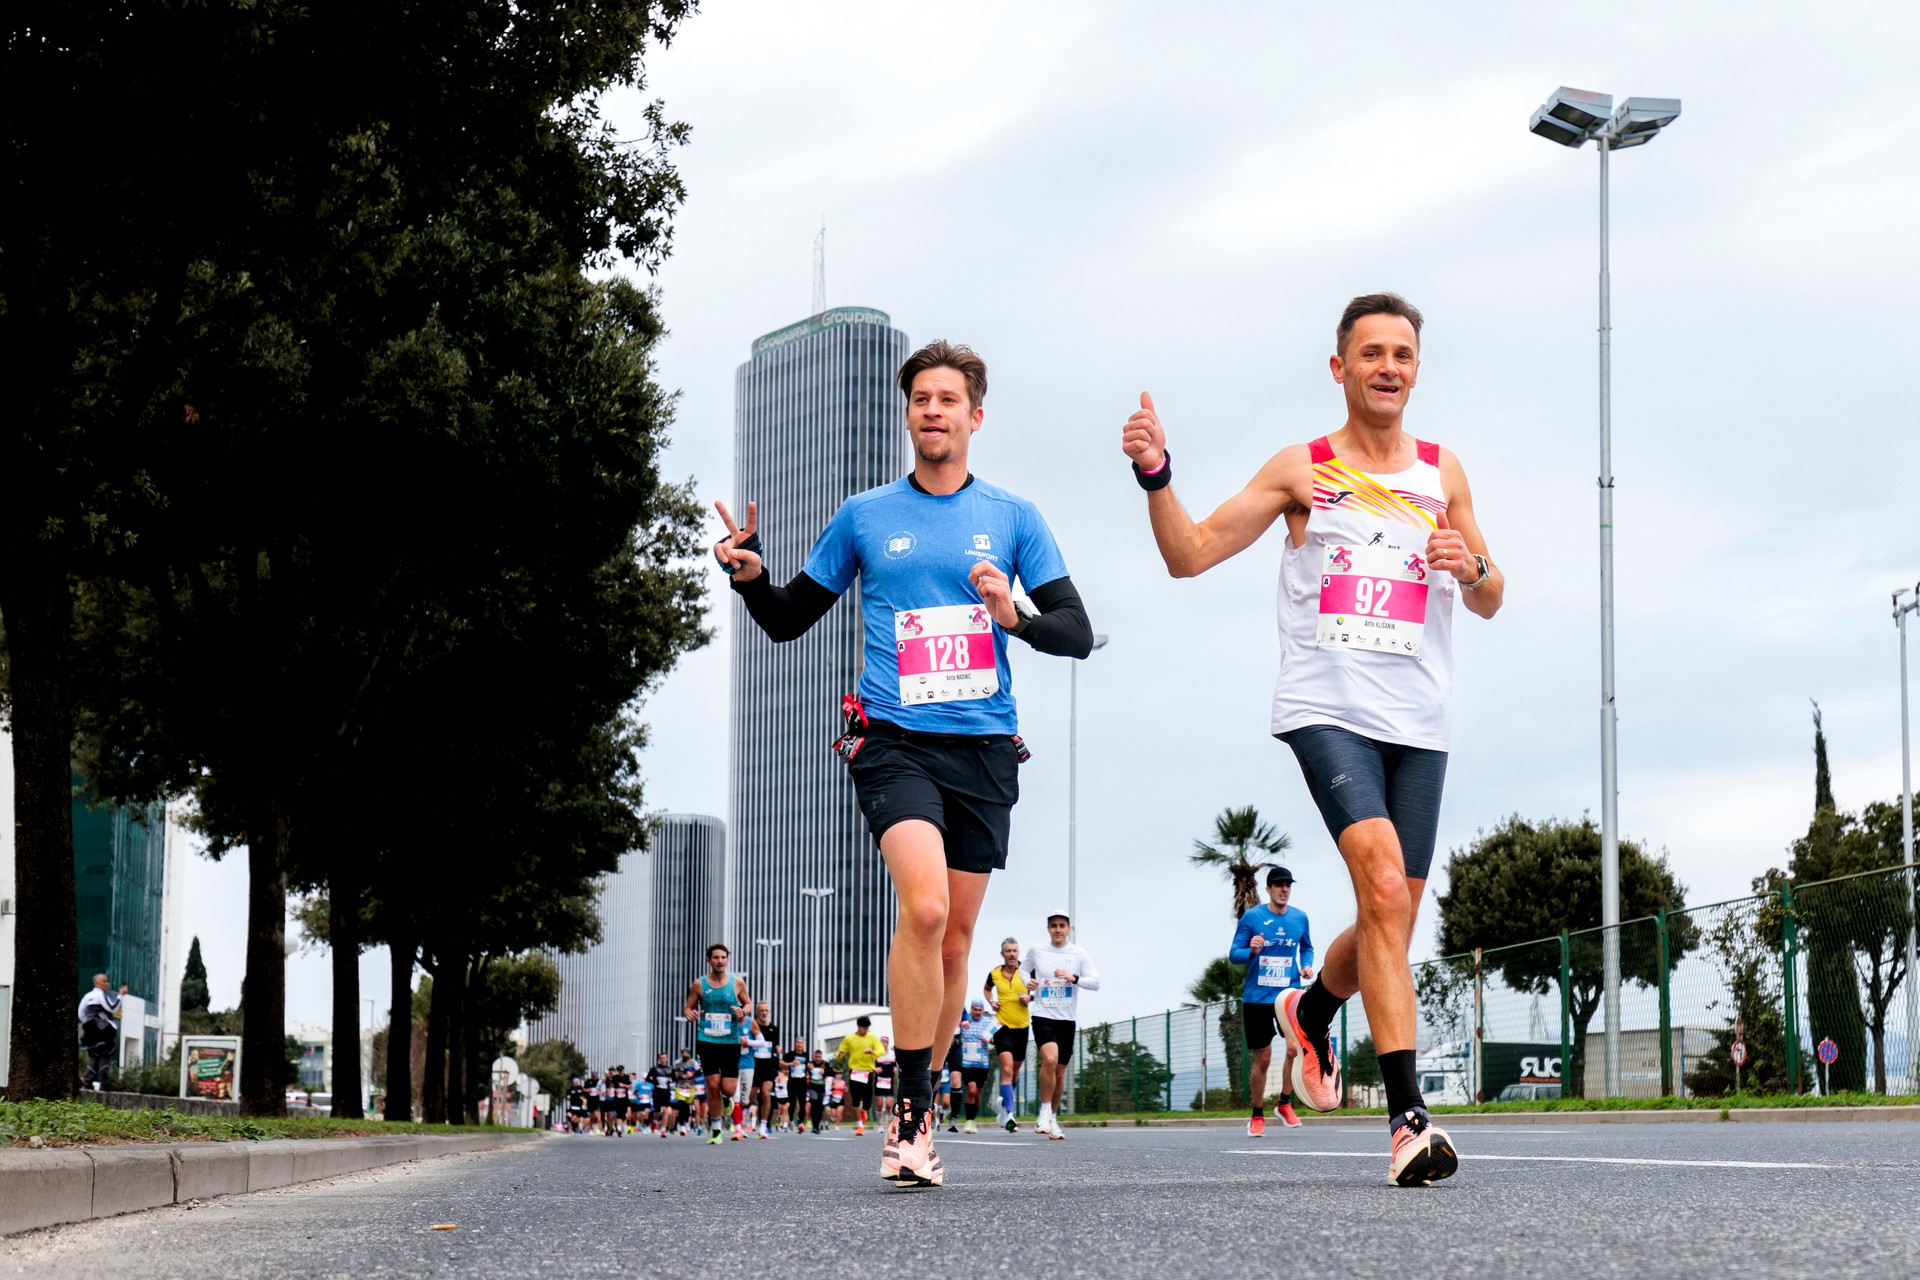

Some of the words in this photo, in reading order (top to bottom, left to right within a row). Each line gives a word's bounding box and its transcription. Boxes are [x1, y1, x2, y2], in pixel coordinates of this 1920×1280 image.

[964, 548, 999, 562] UNISPORT
[1355, 577, 1392, 617] 92
[924, 635, 970, 672] 128
[1265, 966, 1286, 978] 2701
[1047, 987, 1067, 998] 1206
